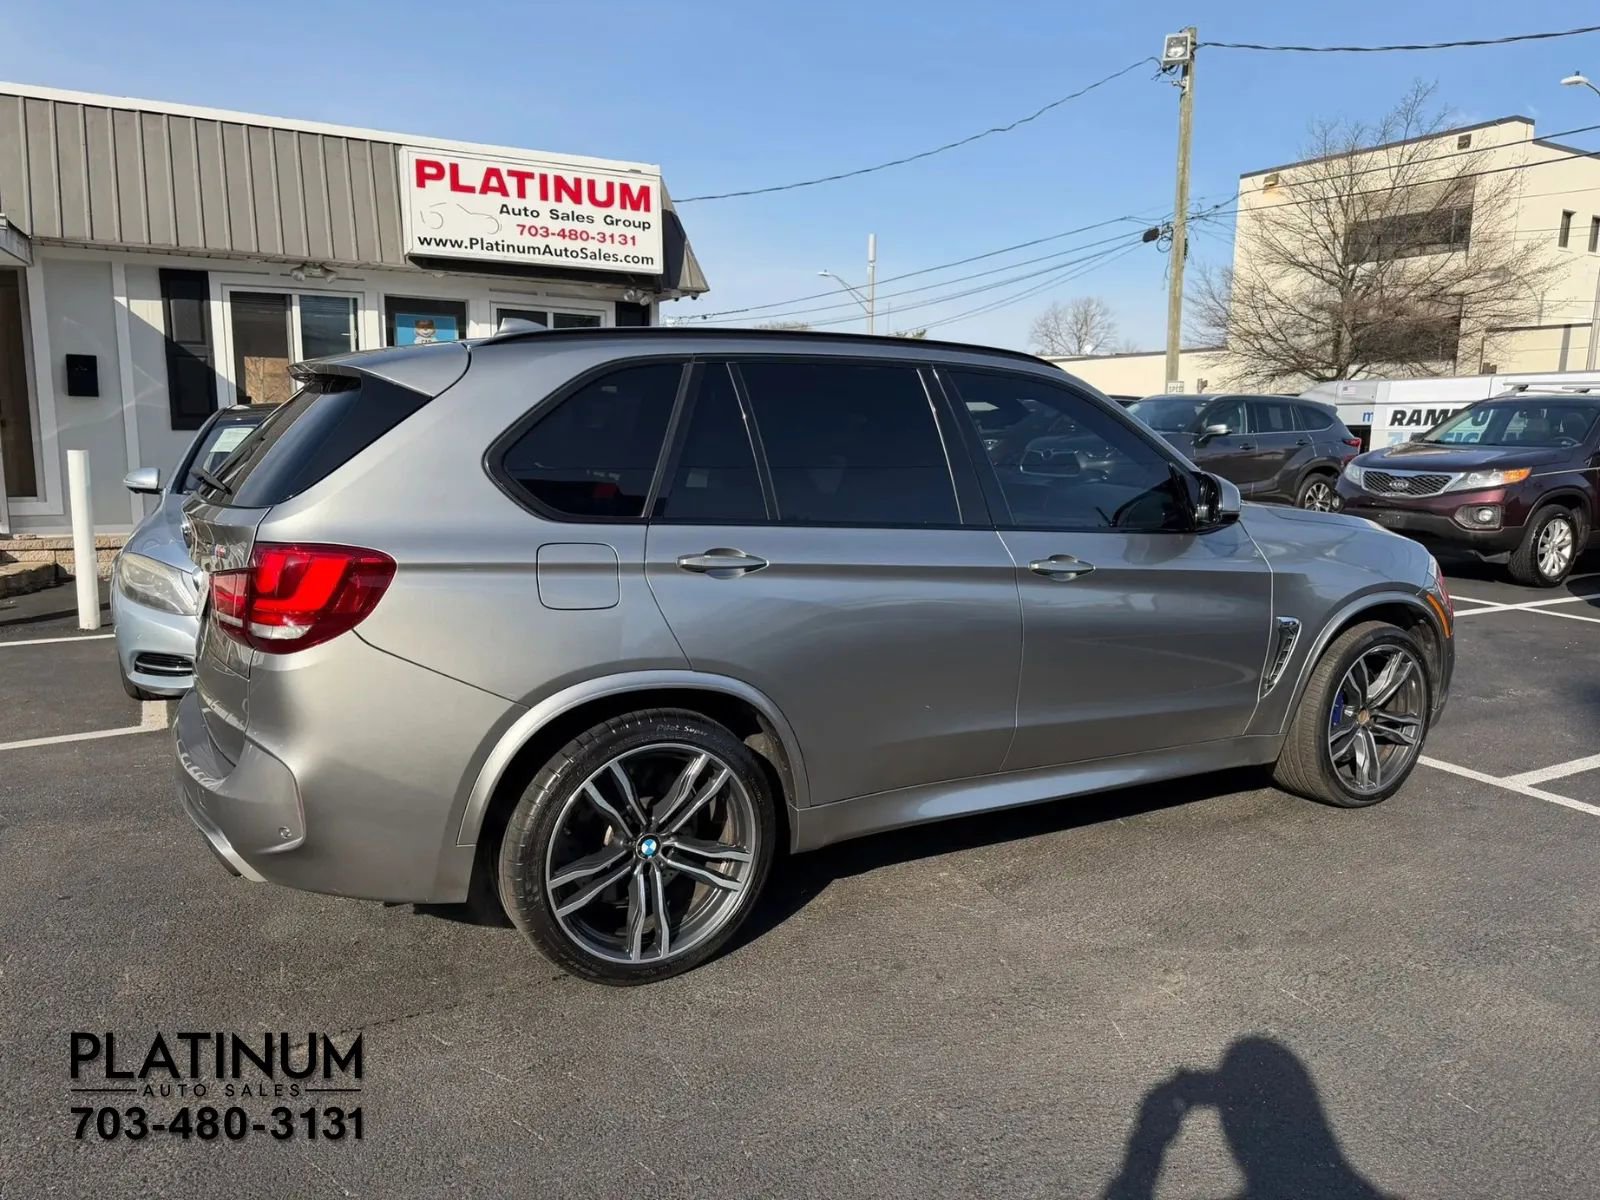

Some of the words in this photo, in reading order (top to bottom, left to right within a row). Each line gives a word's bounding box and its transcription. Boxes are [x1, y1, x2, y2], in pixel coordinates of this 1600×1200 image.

[415, 158, 651, 213] PLATINUM
[499, 203, 540, 218] Auto
[549, 208, 595, 225] Sales
[603, 214, 651, 230] Group
[516, 223, 637, 246] 703-480-3131
[417, 235, 655, 266] www.PlatinumAutoSales.com
